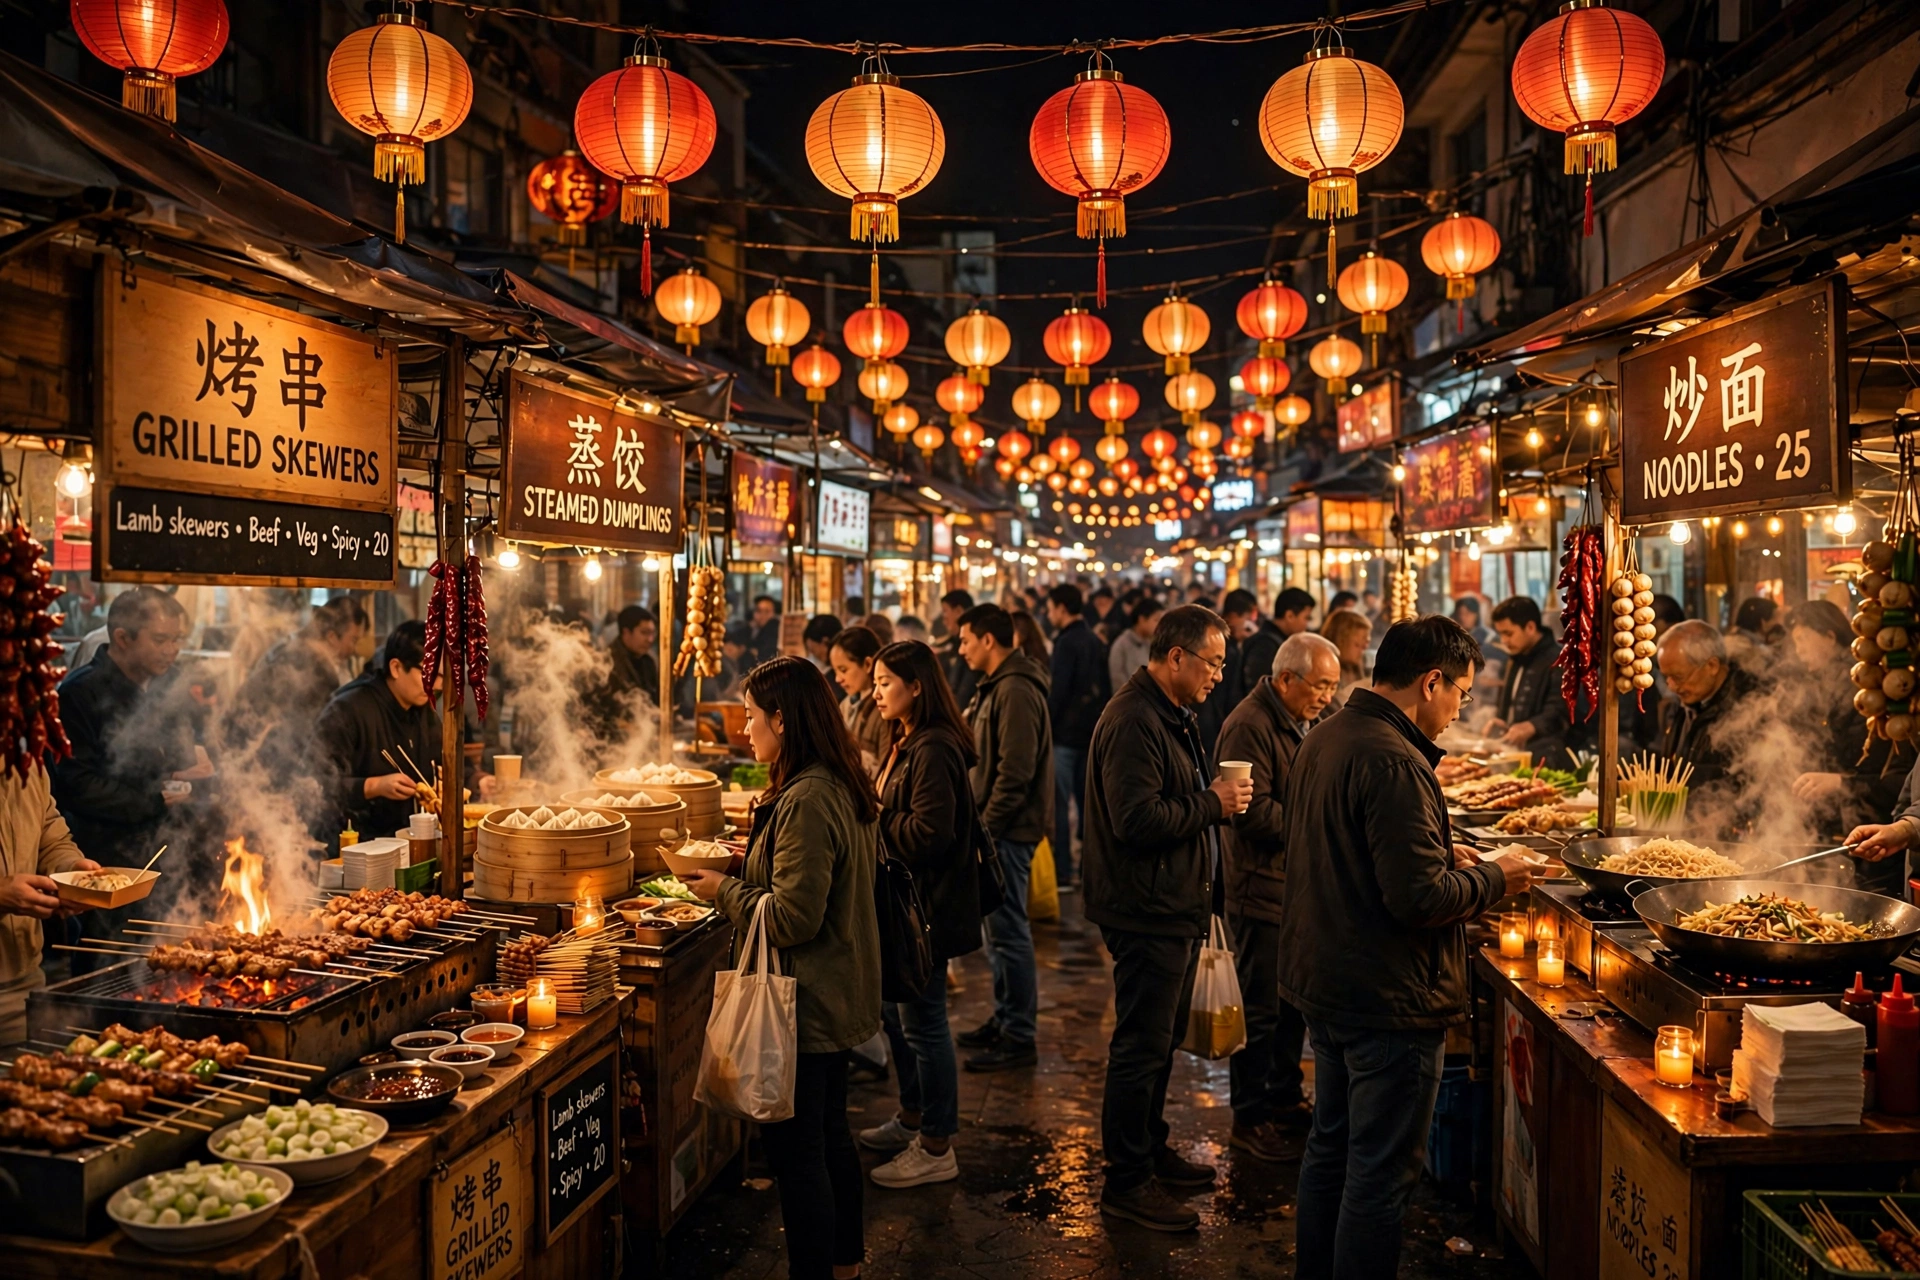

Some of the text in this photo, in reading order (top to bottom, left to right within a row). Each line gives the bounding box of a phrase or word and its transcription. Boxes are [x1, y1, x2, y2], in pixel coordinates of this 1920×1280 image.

[195, 318, 327, 432] 烤串
[1663, 342, 1766, 444] 炒面
[132, 411, 380, 486] GRILLED SKEWERS
[567, 414, 647, 494] 蒸饺
[1643, 429, 1811, 500] NOODLES 25
[116, 501, 163, 533] Lamb
[169, 506, 229, 539] skewers
[249, 517, 280, 546] Beef
[296, 522, 318, 555] Veg
[331, 526, 360, 561] Spicy
[373, 532, 389, 557] 20
[523, 485, 672, 534] STEAMED DUMPLINGS
[552, 1082, 605, 1131] Lamb skewers
[557, 1115, 601, 1161] Beef Veg
[450, 1158, 502, 1231] 烤串
[560, 1143, 606, 1199] Spicy 20
[446, 1202, 510, 1267] GRILLED
[447, 1229, 512, 1280] EWERS
